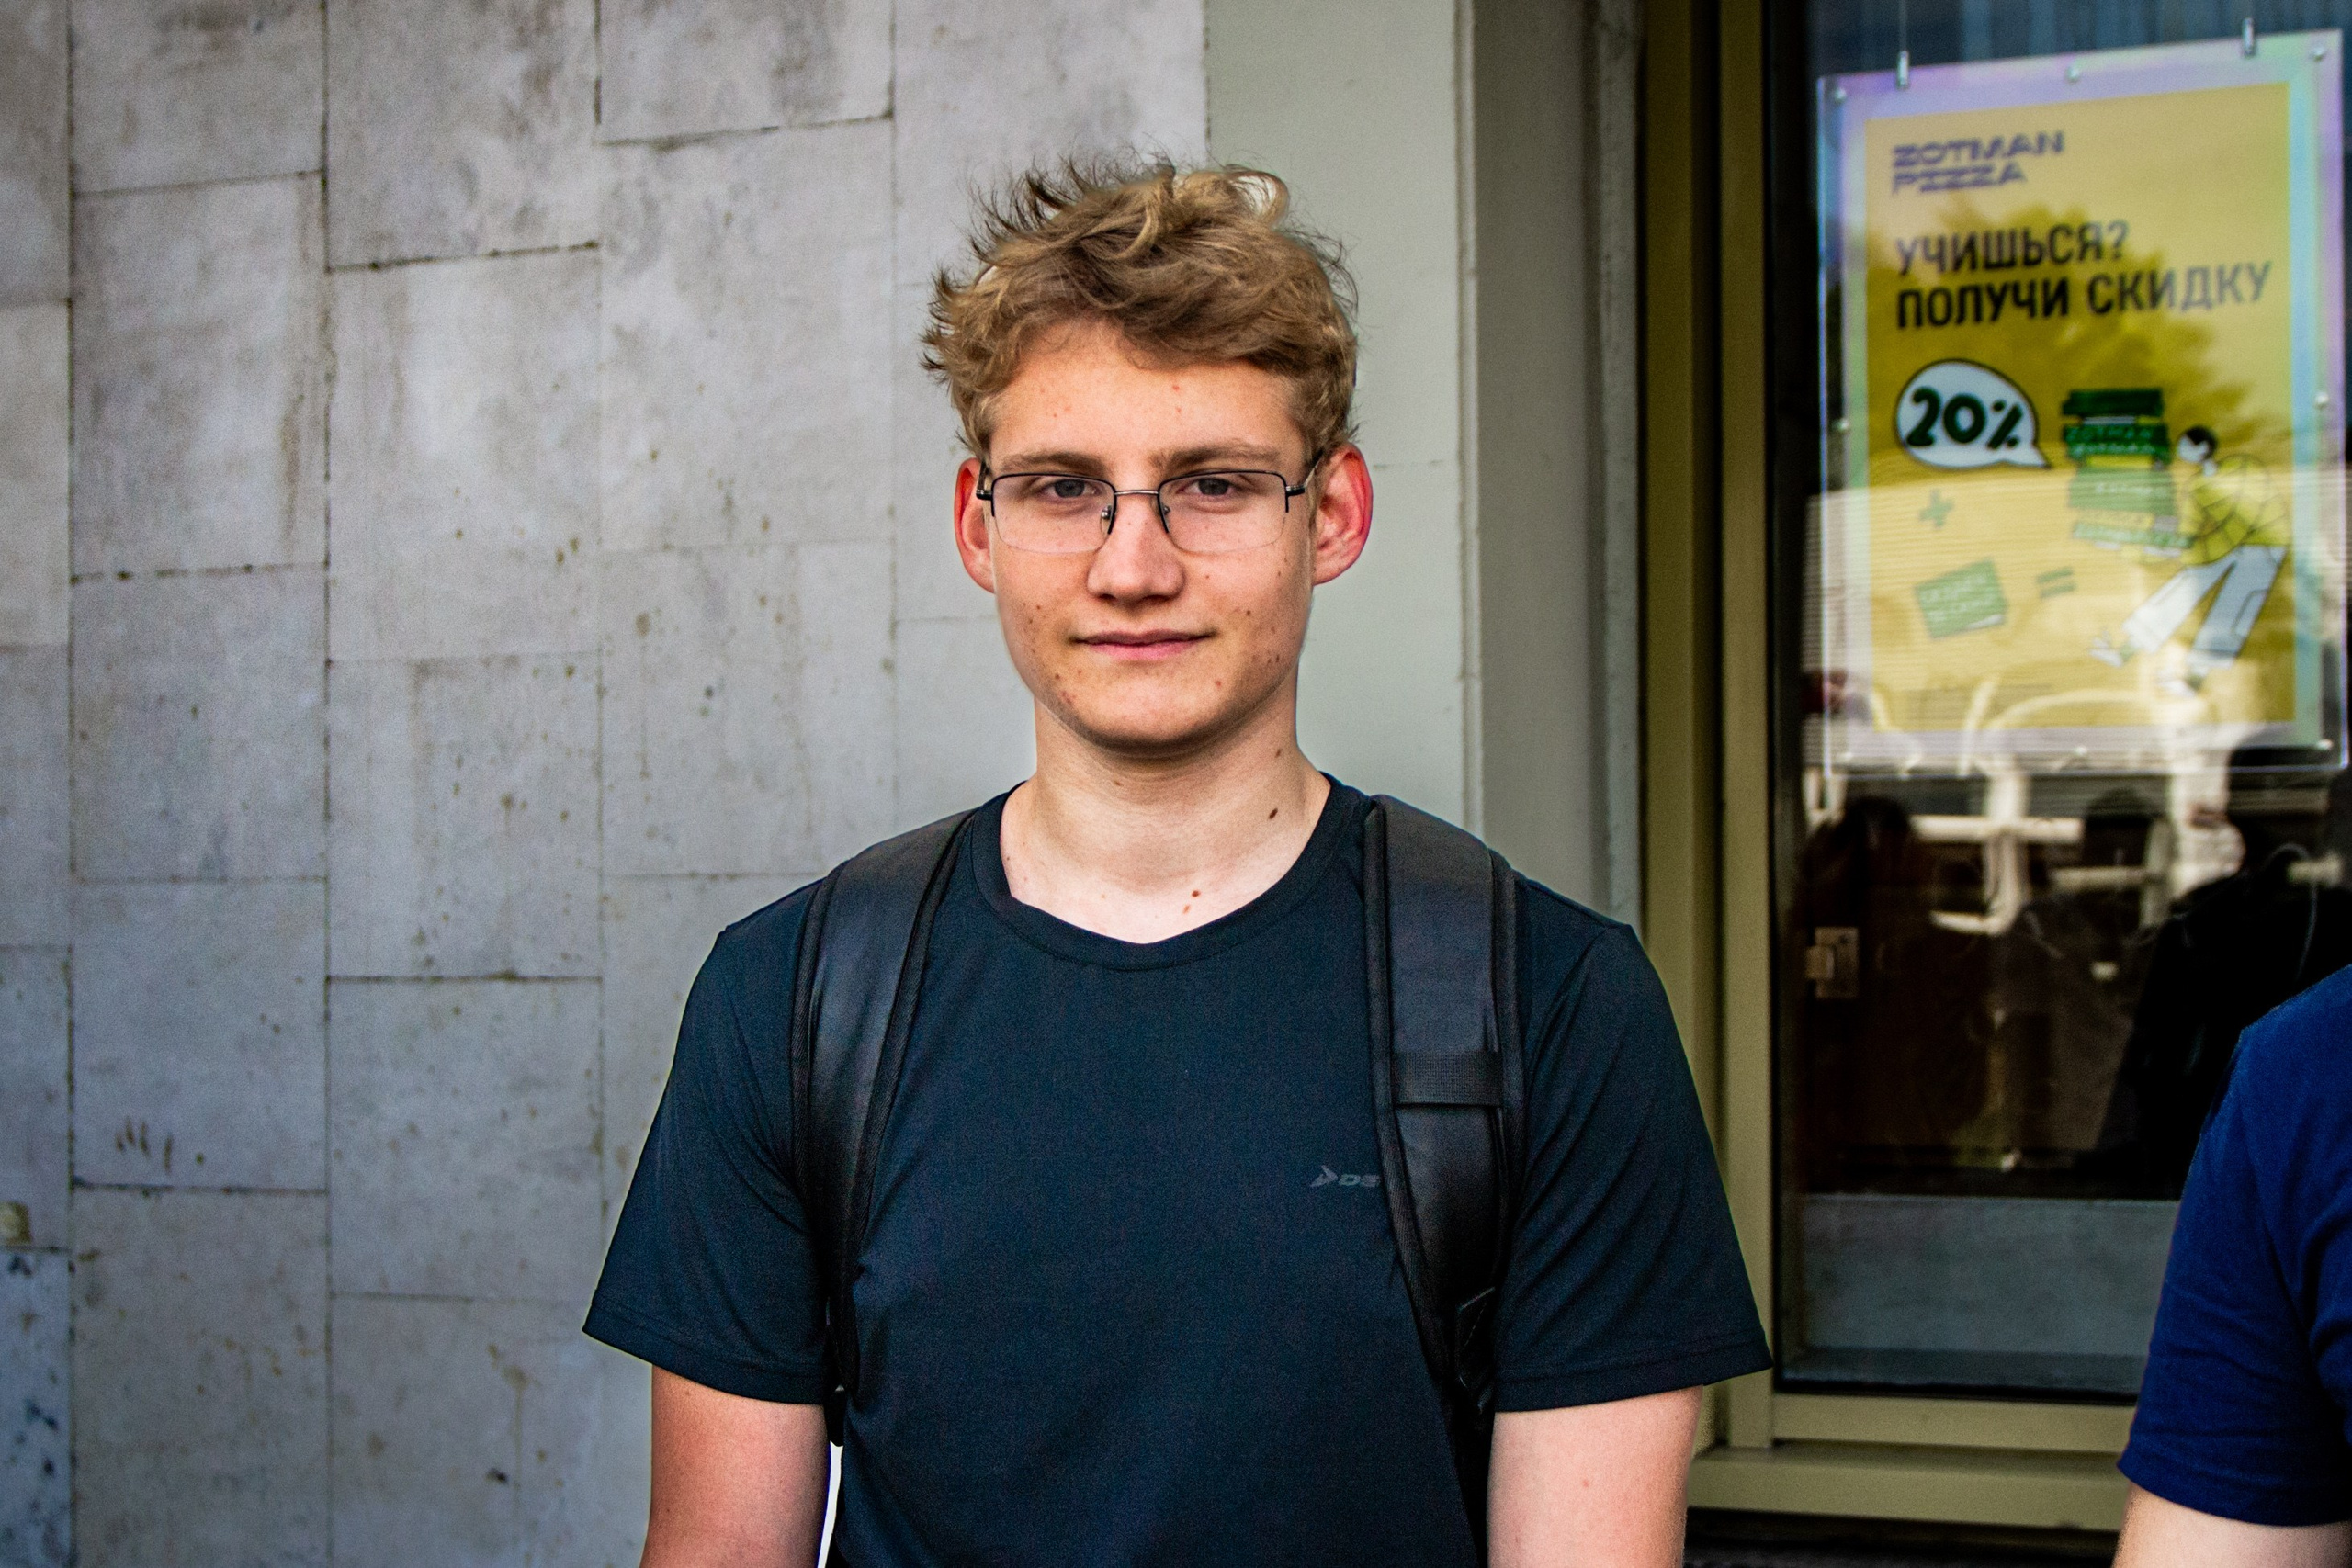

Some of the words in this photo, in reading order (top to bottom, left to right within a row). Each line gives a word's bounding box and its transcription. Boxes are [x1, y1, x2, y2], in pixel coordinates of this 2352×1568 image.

[1897, 220, 2129, 275] УЧИШЬСЯ?
[1898, 278, 2070, 329] ПОЛУЧИ
[2087, 263, 2272, 314] СКИДКУ
[1905, 387, 2023, 449] 20%
